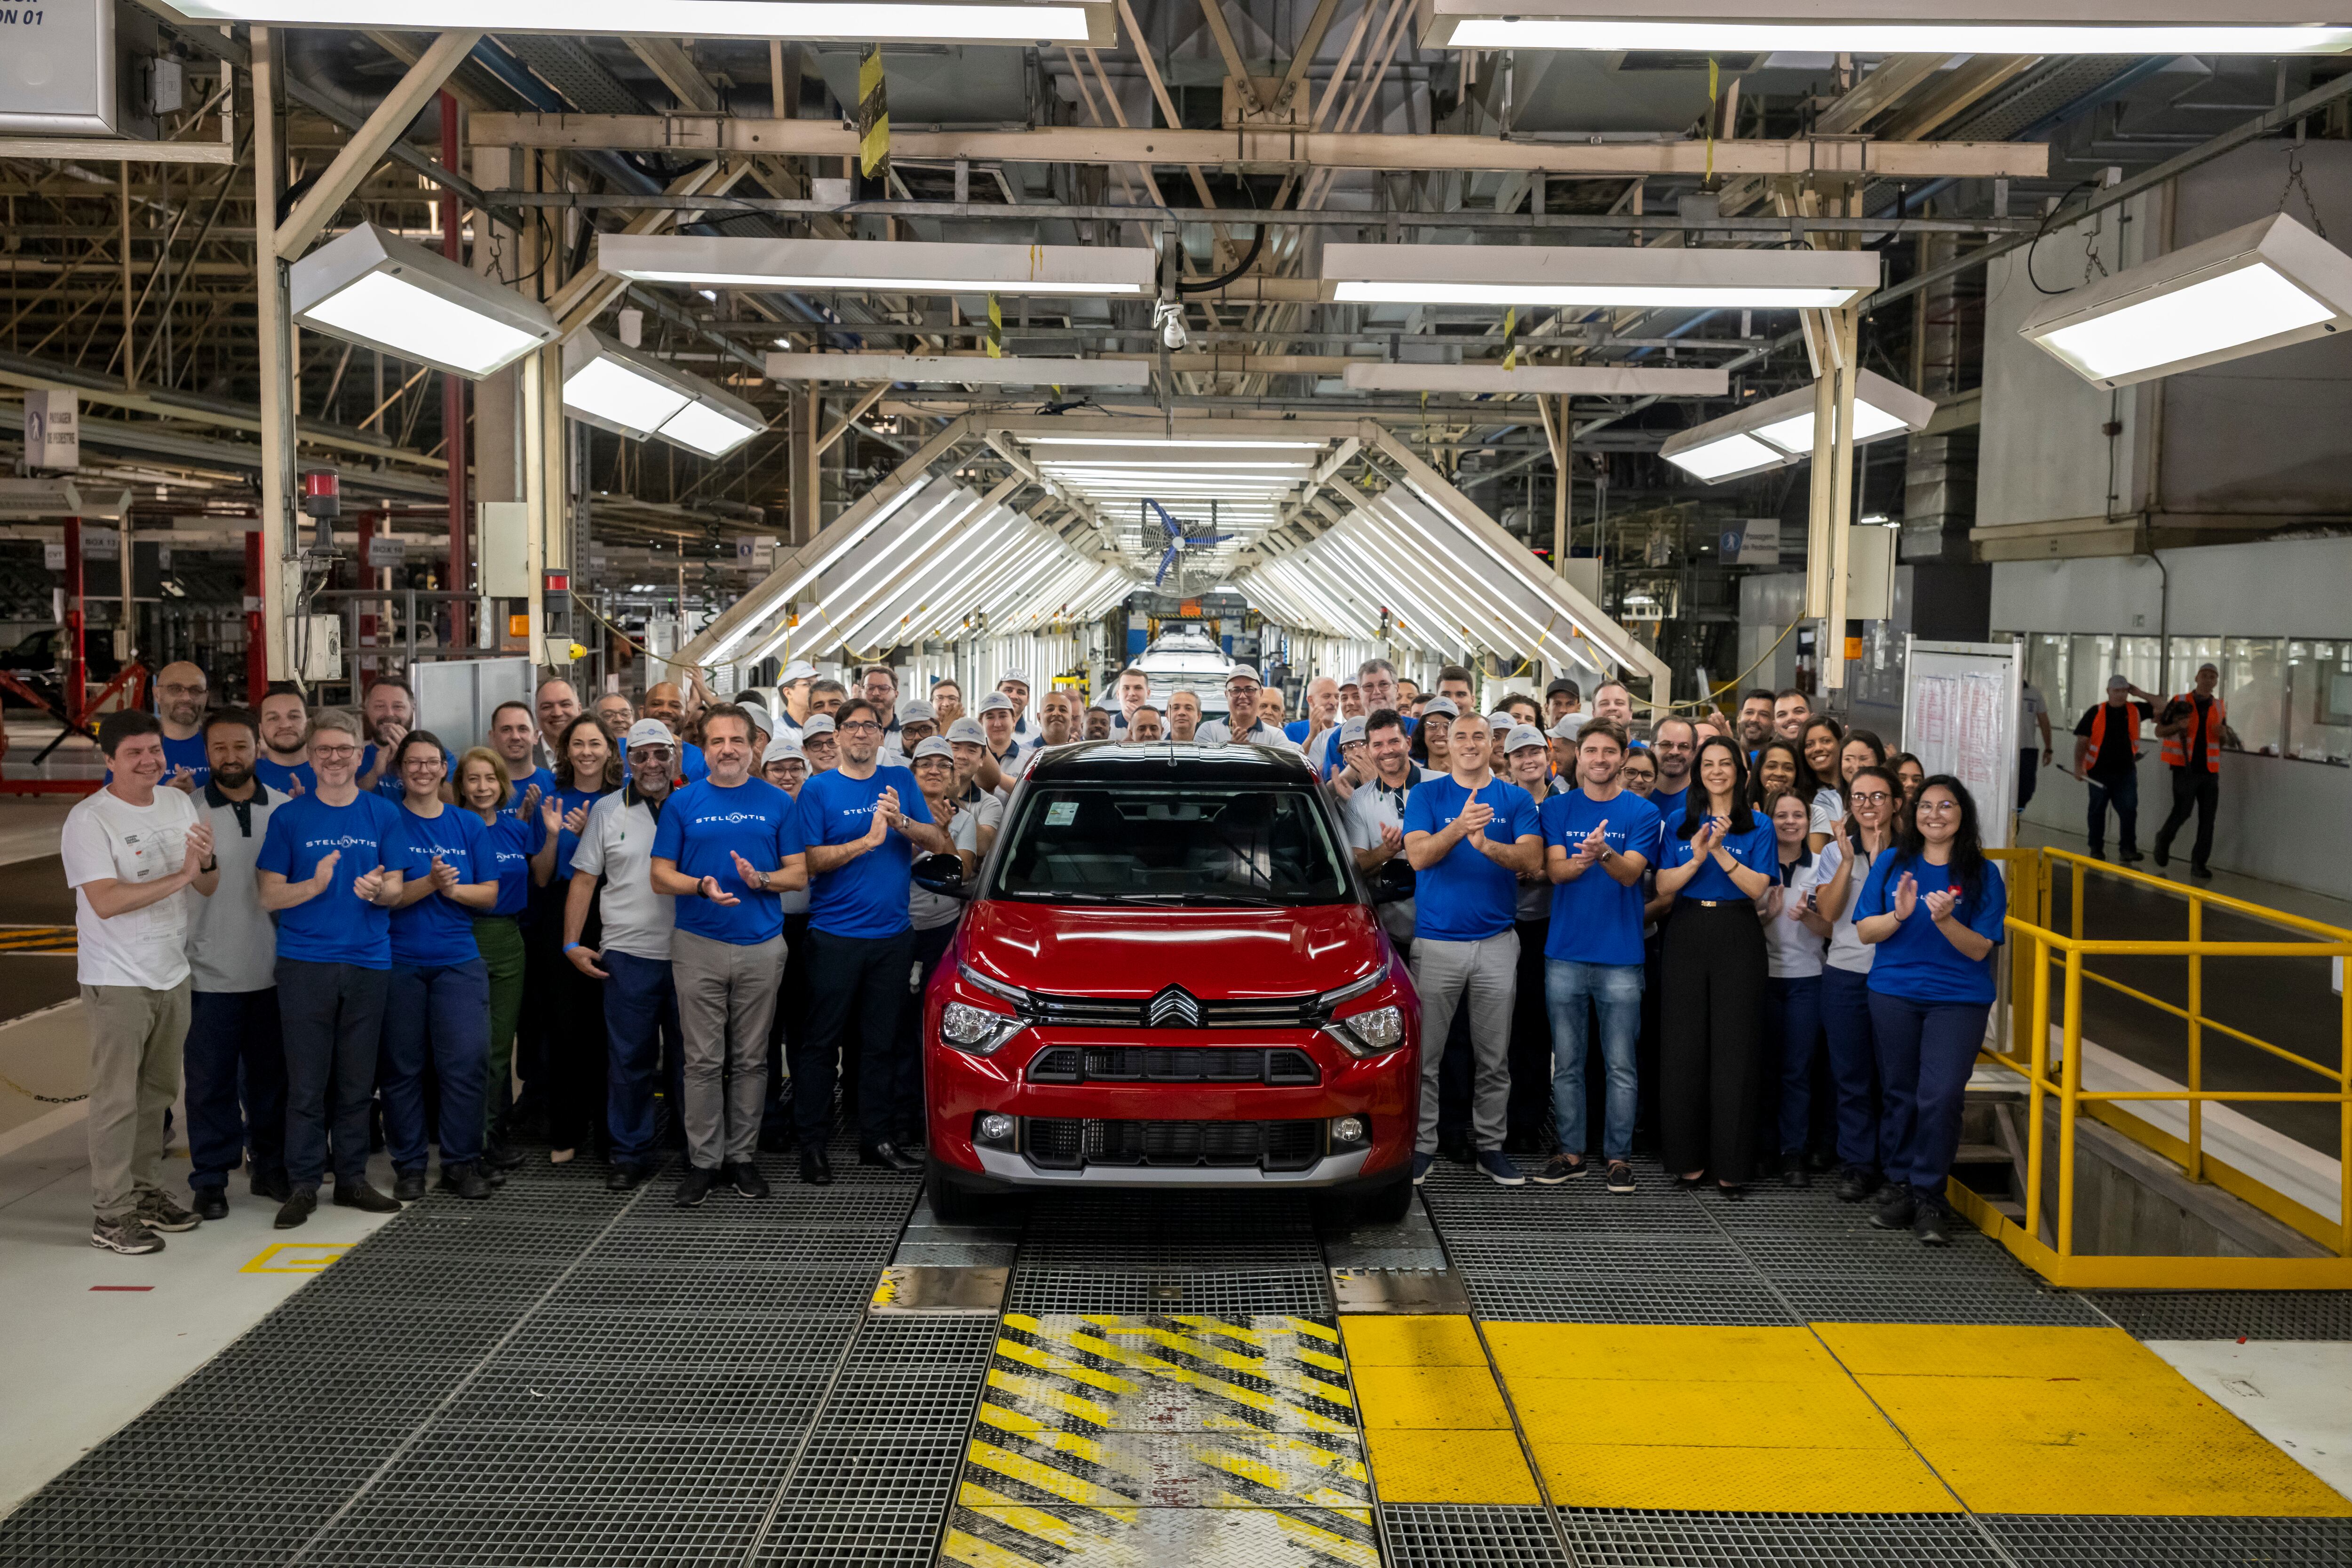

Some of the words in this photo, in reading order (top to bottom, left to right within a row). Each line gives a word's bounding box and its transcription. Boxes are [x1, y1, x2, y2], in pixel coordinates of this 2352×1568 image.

[23, 10, 43, 25] 01
[696, 812, 765, 824] STELLANTIS
[306, 836, 377, 848] STELLANTIS
